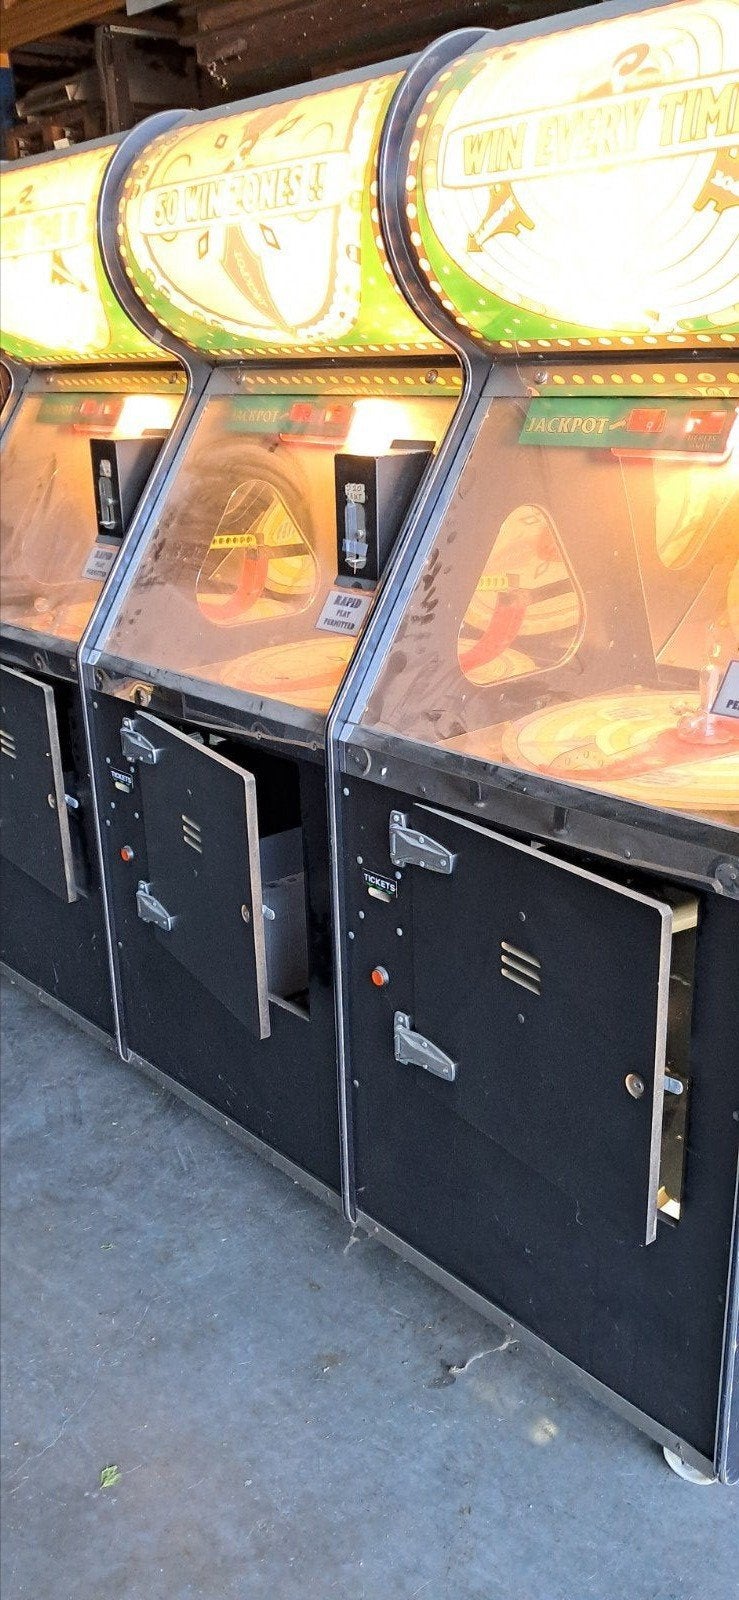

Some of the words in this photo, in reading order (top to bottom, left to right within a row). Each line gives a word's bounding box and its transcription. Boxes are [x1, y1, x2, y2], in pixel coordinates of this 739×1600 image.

[463, 121, 528, 177] WIN
[534, 96, 650, 168] EVERY
[184, 180, 223, 223] WIN
[525, 416, 610, 434] JACKPOT
[334, 595, 362, 608] RAPID
[323, 618, 356, 630] PERMITTED
[364, 873, 396, 892] TICKETS
